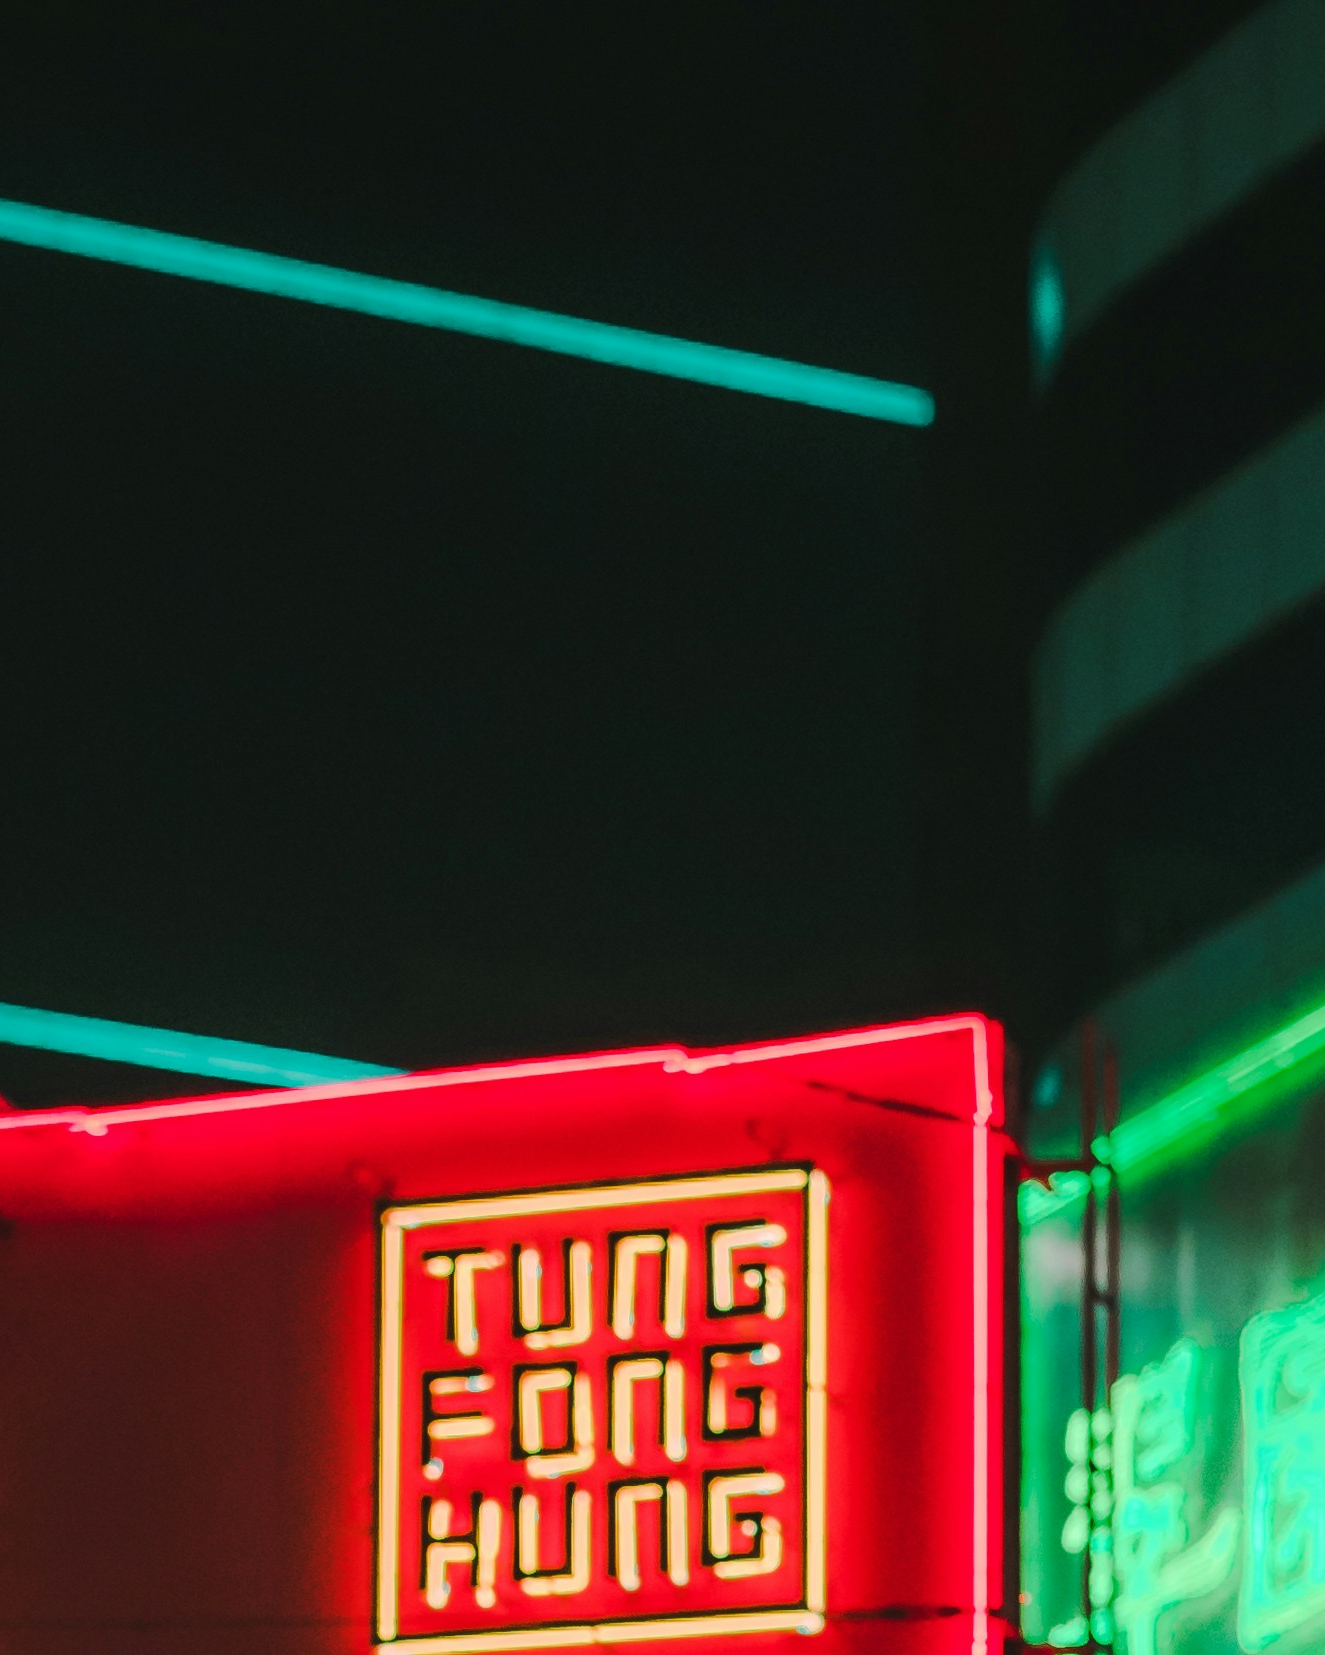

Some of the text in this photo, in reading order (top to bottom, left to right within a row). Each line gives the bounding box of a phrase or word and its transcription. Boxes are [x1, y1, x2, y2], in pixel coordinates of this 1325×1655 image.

[424, 1222, 788, 1358] TUNG
[424, 1342, 782, 1480] FONG
[424, 1472, 786, 1610] HUNG
